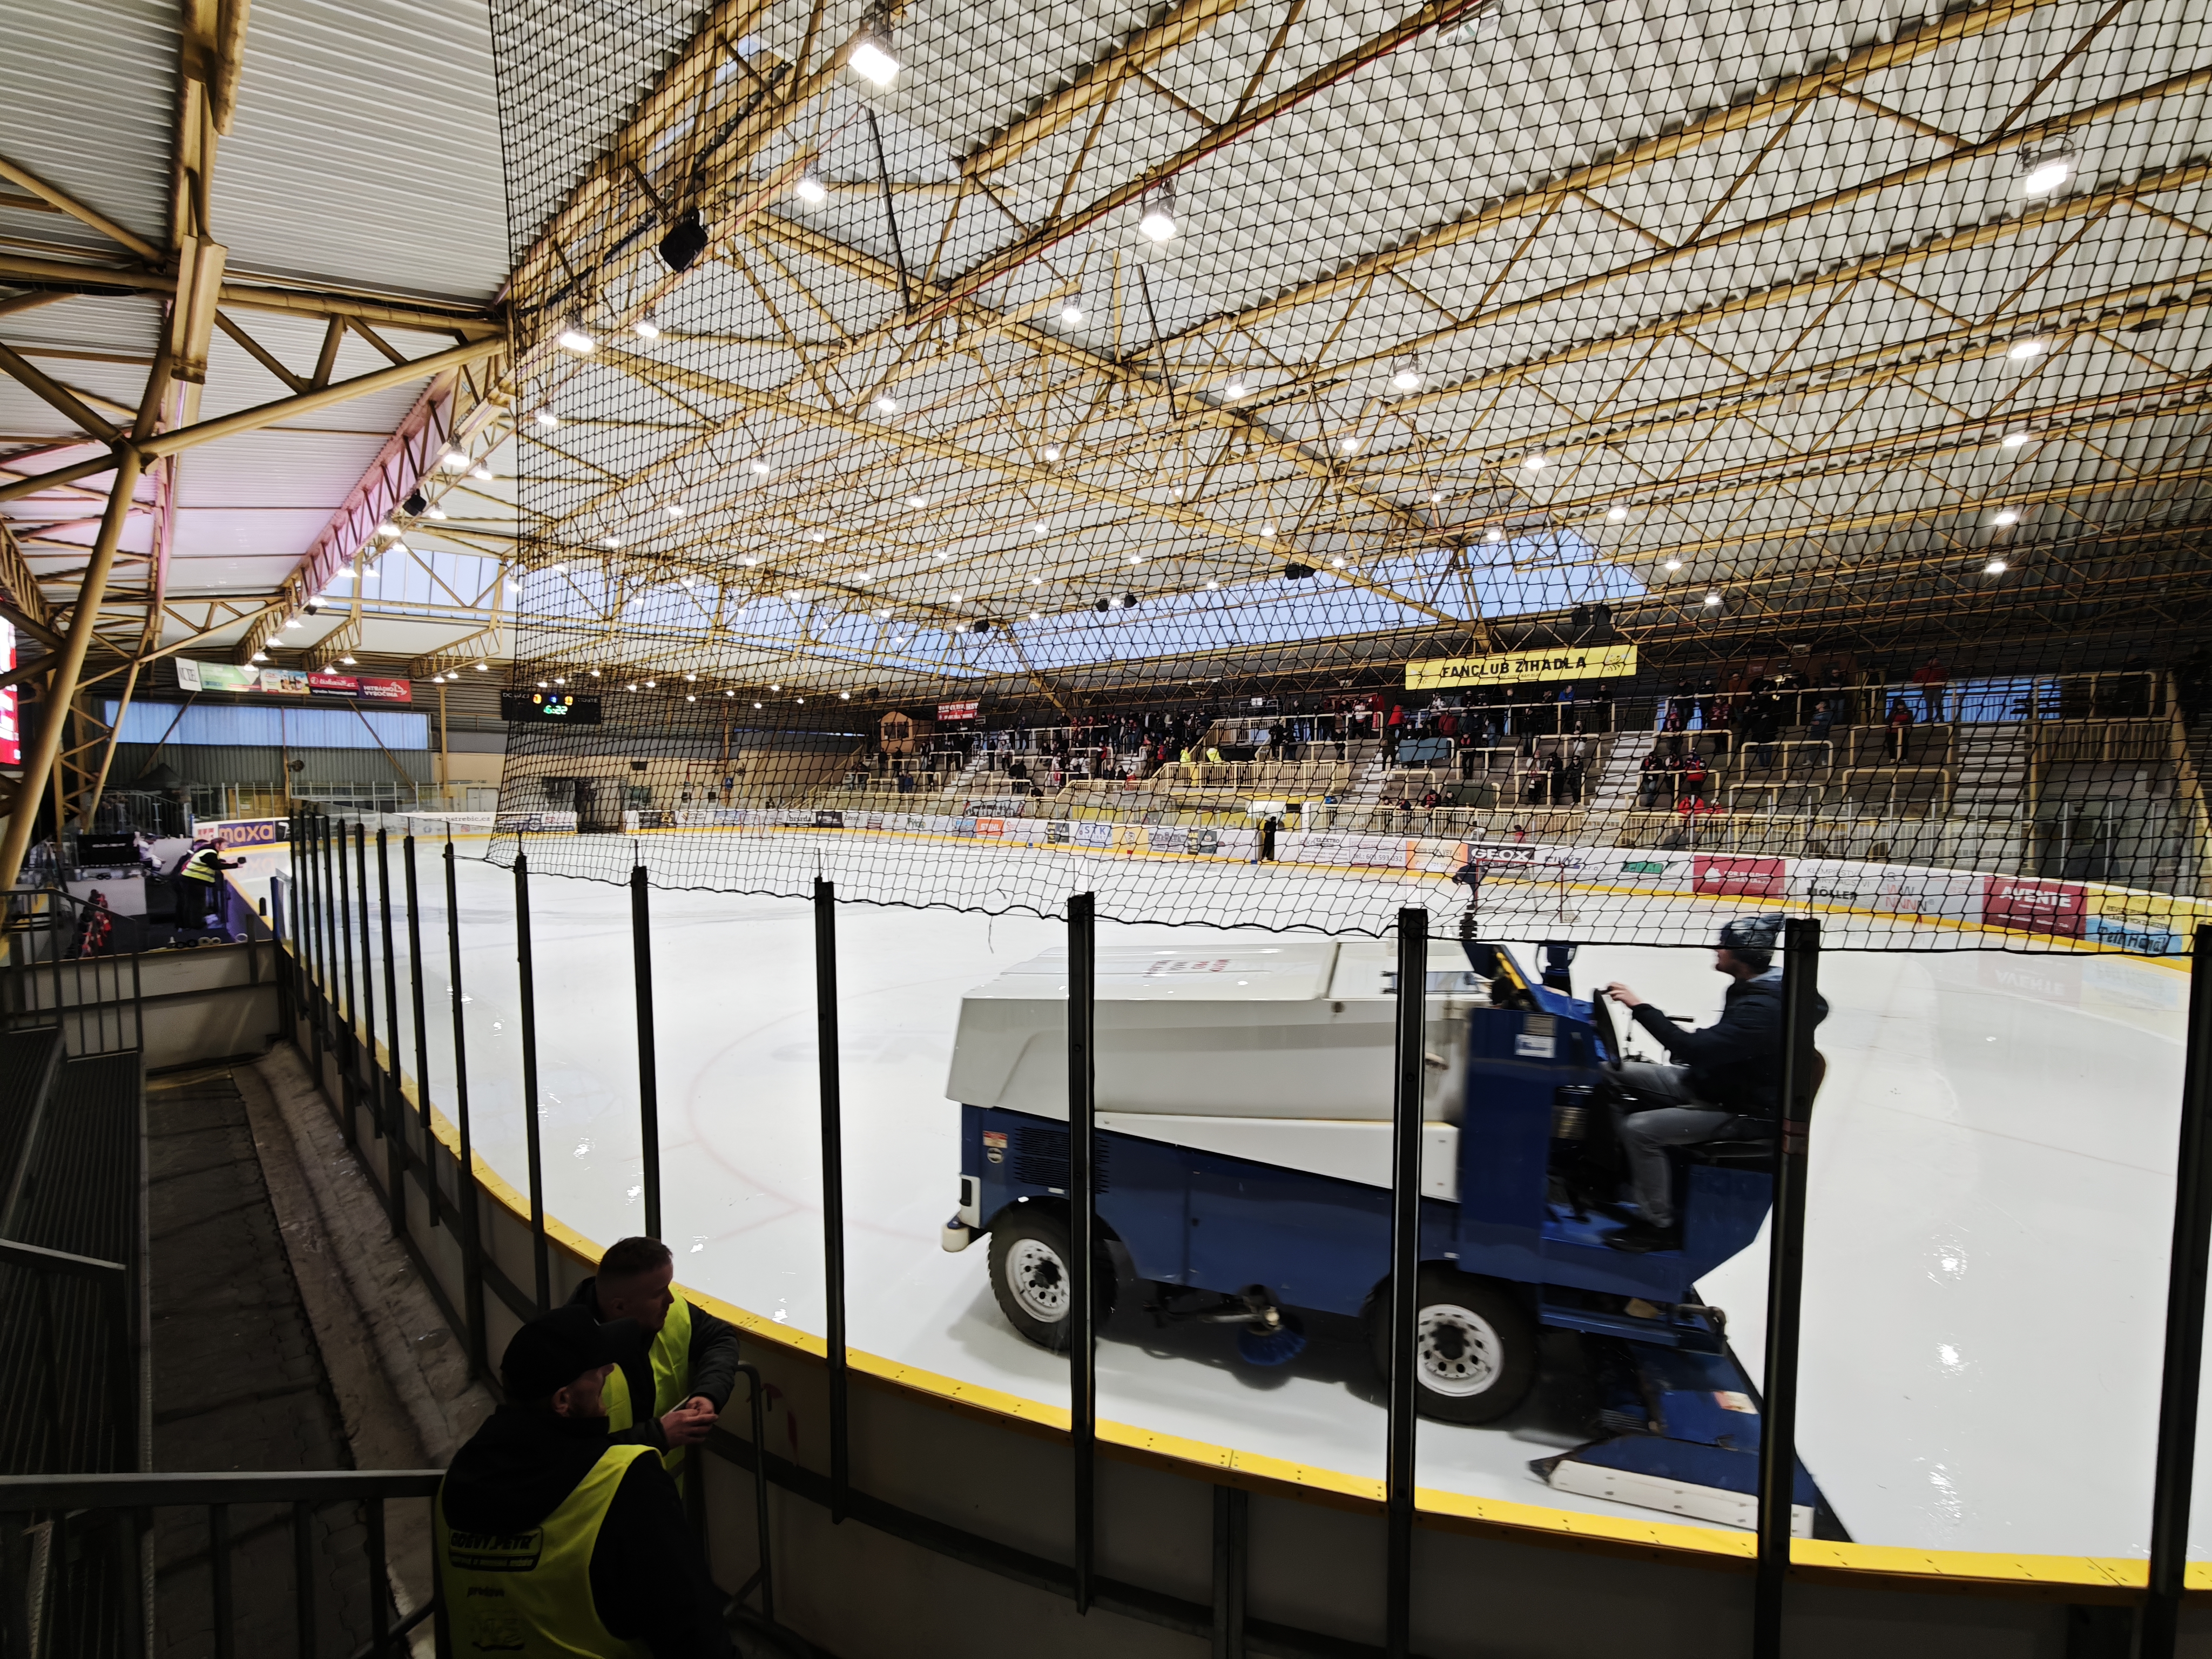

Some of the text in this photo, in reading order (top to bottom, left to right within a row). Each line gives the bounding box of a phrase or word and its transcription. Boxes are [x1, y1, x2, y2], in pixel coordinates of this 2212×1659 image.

[219, 824, 274, 843] maxa
[980, 823, 1000, 831] STIHL
[1084, 826, 1106, 835] STK
[1999, 886, 2072, 908] AVENTE
